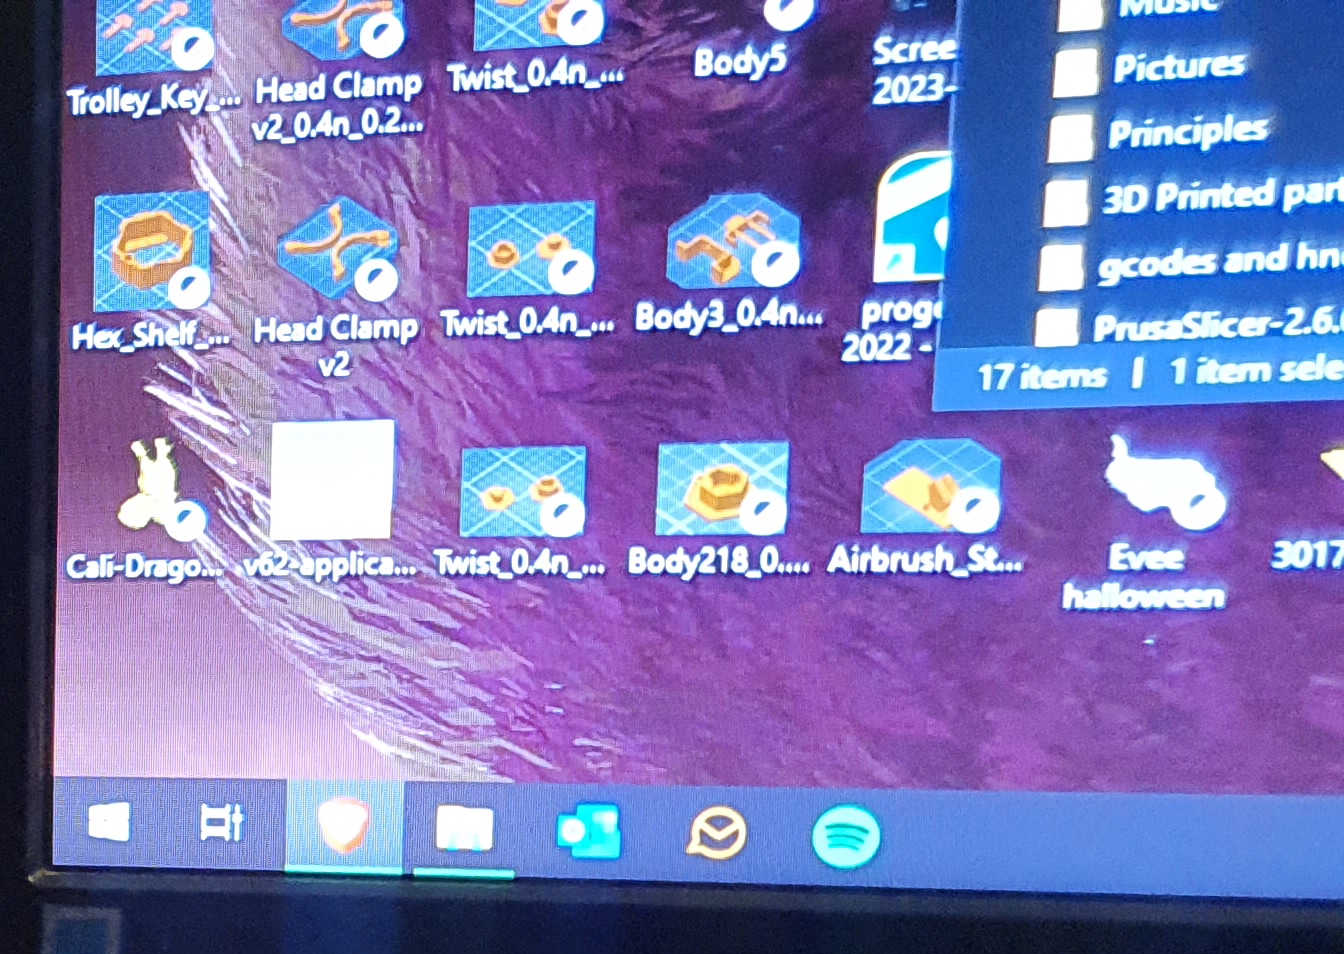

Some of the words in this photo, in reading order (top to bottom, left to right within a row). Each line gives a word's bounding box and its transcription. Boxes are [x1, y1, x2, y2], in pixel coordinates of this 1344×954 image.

[693, 43, 788, 82] Body5
[1113, 52, 1250, 84] Pictures
[256, 77, 325, 105] Head
[332, 69, 424, 104] Clamp
[1107, 112, 1271, 152] Principles
[1103, 184, 1149, 214] 3D
[1155, 177, 1278, 212] Printed
[1097, 247, 1217, 287] gcodes
[1224, 242, 1291, 273] and
[1296, 241, 1344, 271] hn
[254, 320, 322, 344] Head
[330, 314, 419, 345] Clamp
[841, 332, 913, 363] 2022
[318, 354, 351, 377] v2
[978, 362, 1015, 391] 17
[1019, 362, 1109, 391] items
[1170, 357, 1188, 385] 1
[1195, 356, 1273, 385] item
[1109, 542, 1185, 571] Evee
[1063, 582, 1226, 610] halloween
